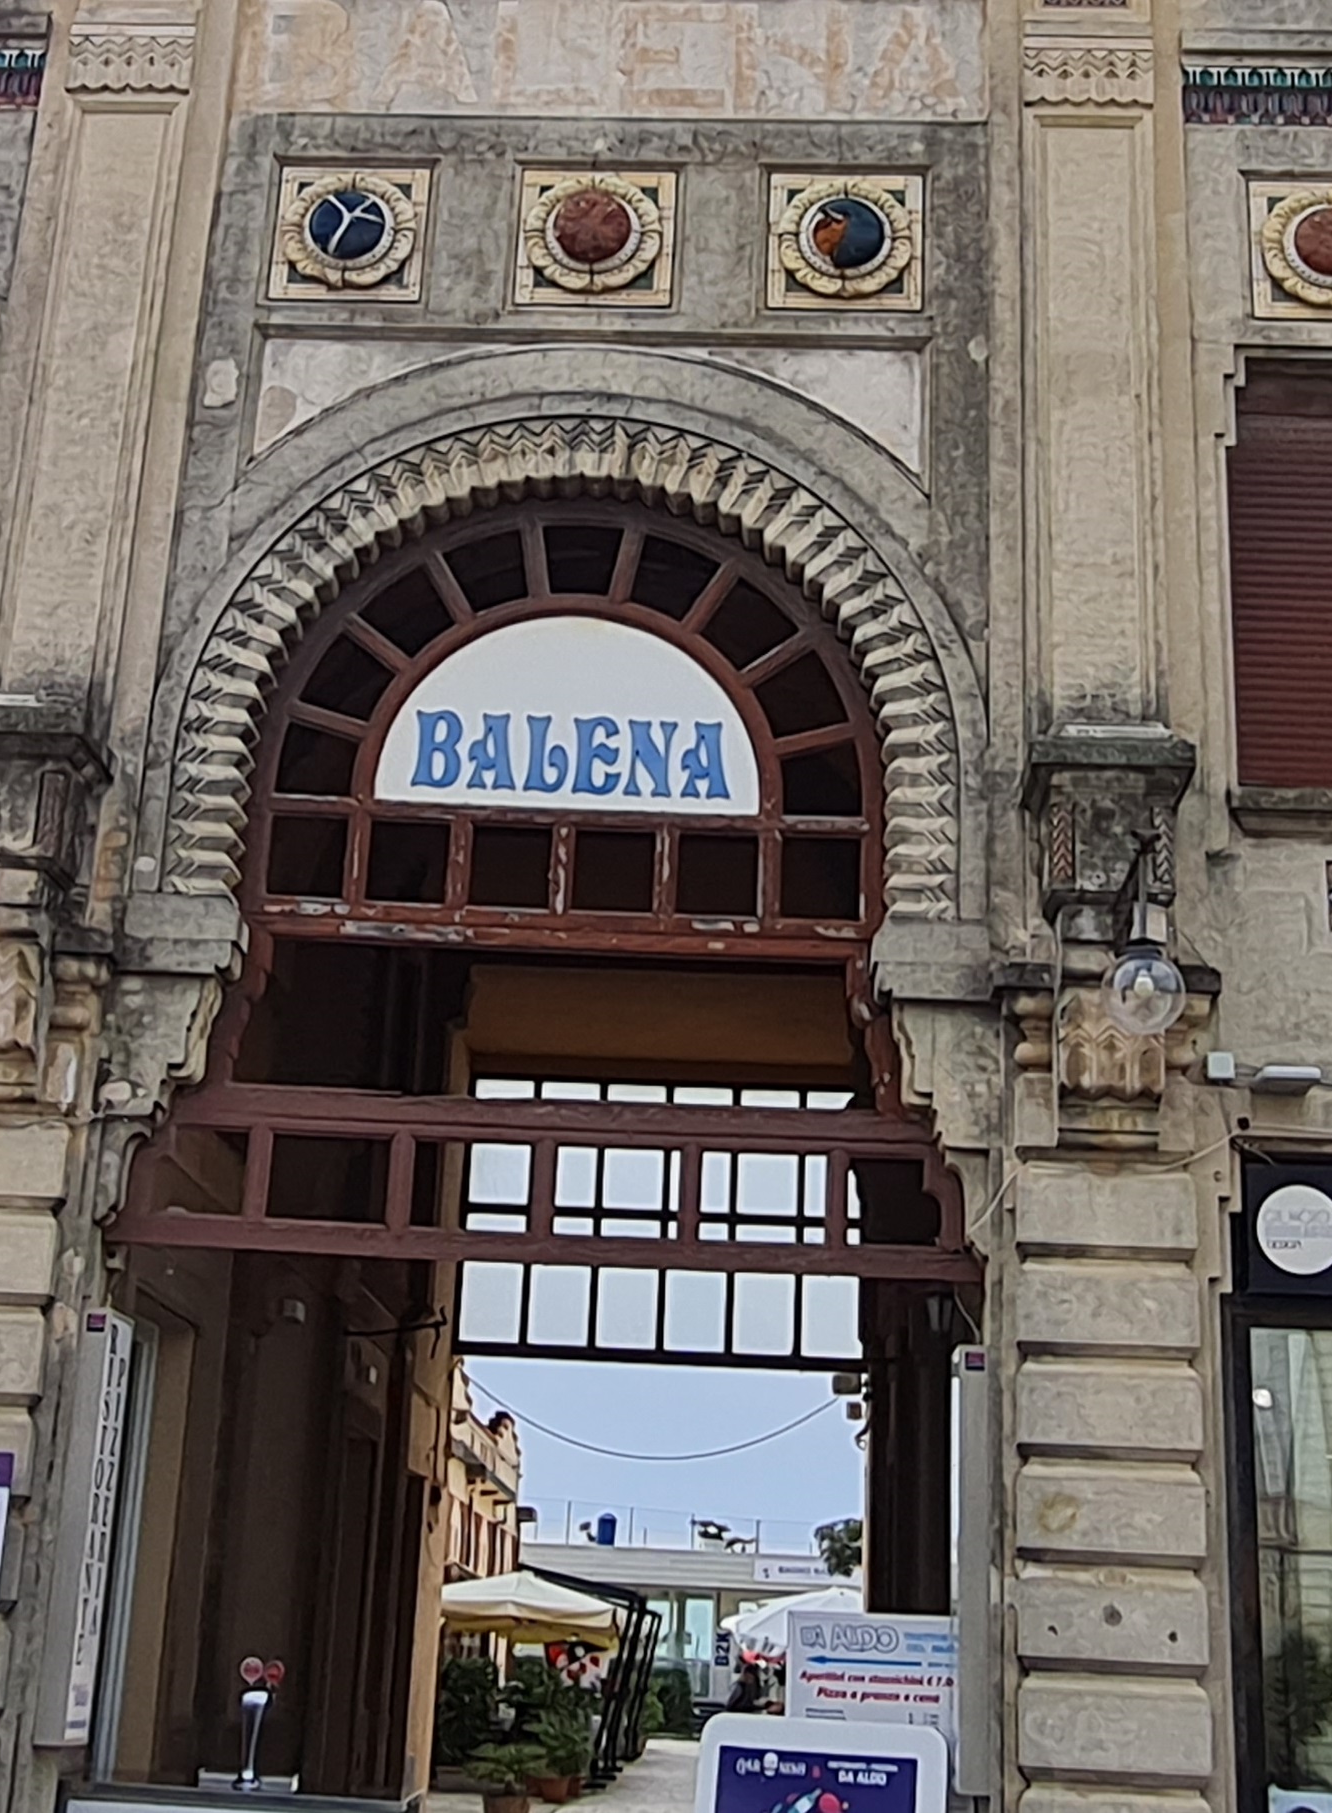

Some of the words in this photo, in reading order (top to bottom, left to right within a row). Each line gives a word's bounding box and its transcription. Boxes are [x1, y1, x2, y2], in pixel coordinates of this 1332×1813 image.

[245, 0, 969, 112] BALENA
[410, 709, 731, 800] BALENA
[75, 1322, 119, 1666] RISTORANTE
[88, 1357, 127, 1636] PIZZERIA
[800, 1624, 826, 1650] DA
[830, 1623, 899, 1654] ALDO
[817, 1686, 847, 1699] Pizza
